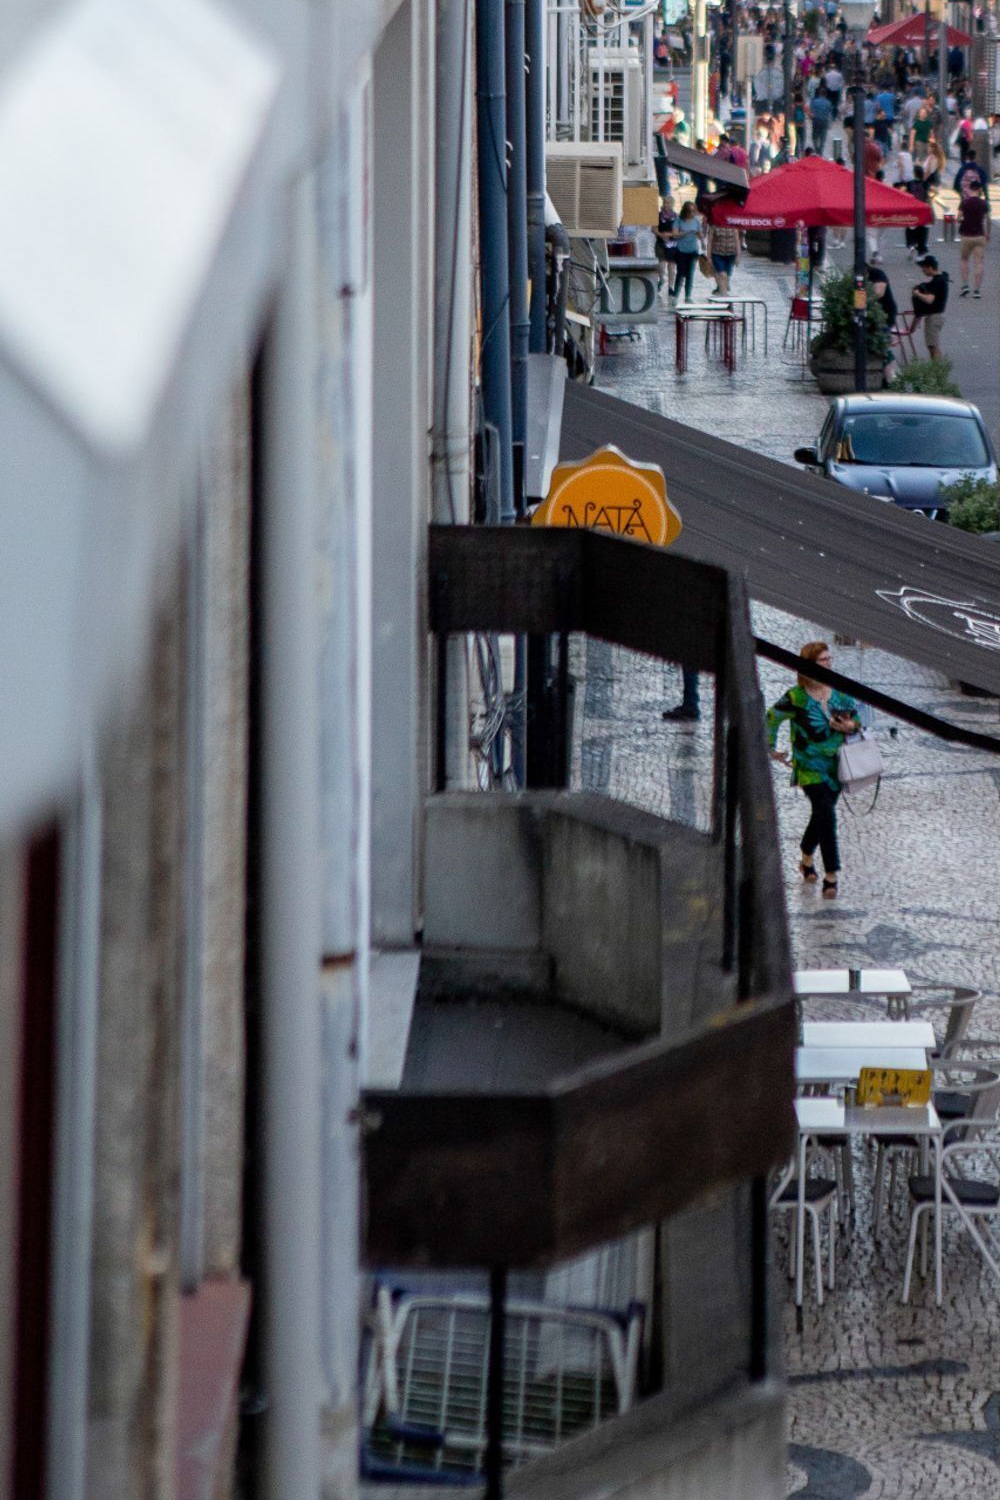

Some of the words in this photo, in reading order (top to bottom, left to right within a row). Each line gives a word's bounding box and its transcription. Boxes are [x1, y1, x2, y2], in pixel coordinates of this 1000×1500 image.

[727, 217, 750, 226] SUPER
[751, 219, 772, 227] BOCK
[562, 499, 654, 544] NATA
